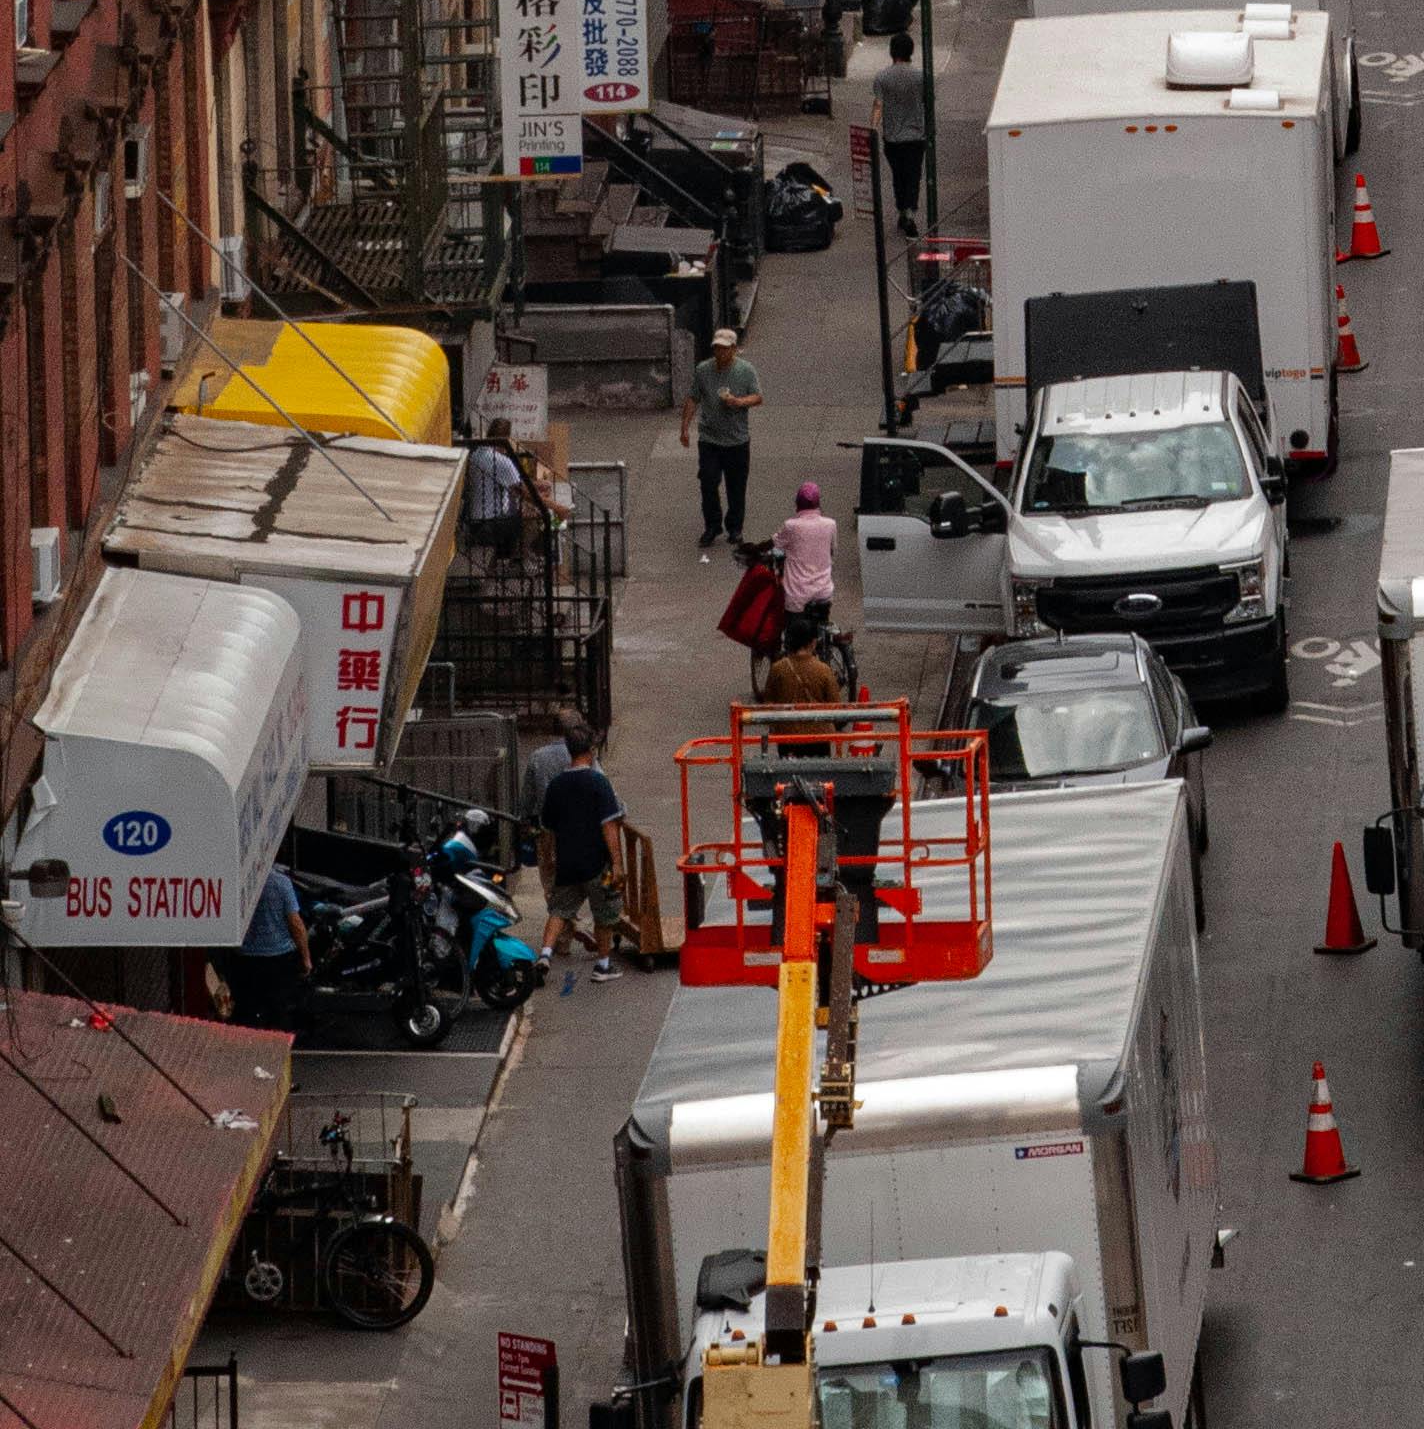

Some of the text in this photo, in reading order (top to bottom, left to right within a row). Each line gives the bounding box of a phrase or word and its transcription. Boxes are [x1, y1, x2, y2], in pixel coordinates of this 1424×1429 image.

[595, 84, 628, 100] 114
[518, 121, 565, 139] JIN'S
[518, 139, 566, 154] Printing
[1265, 367, 1307, 380] viptogo
[336, 591, 385, 750] 中藥行
[112, 820, 159, 847] 120
[66, 875, 223, 919] BUS STATION
[1028, 1142, 1082, 1158] MORGAN
